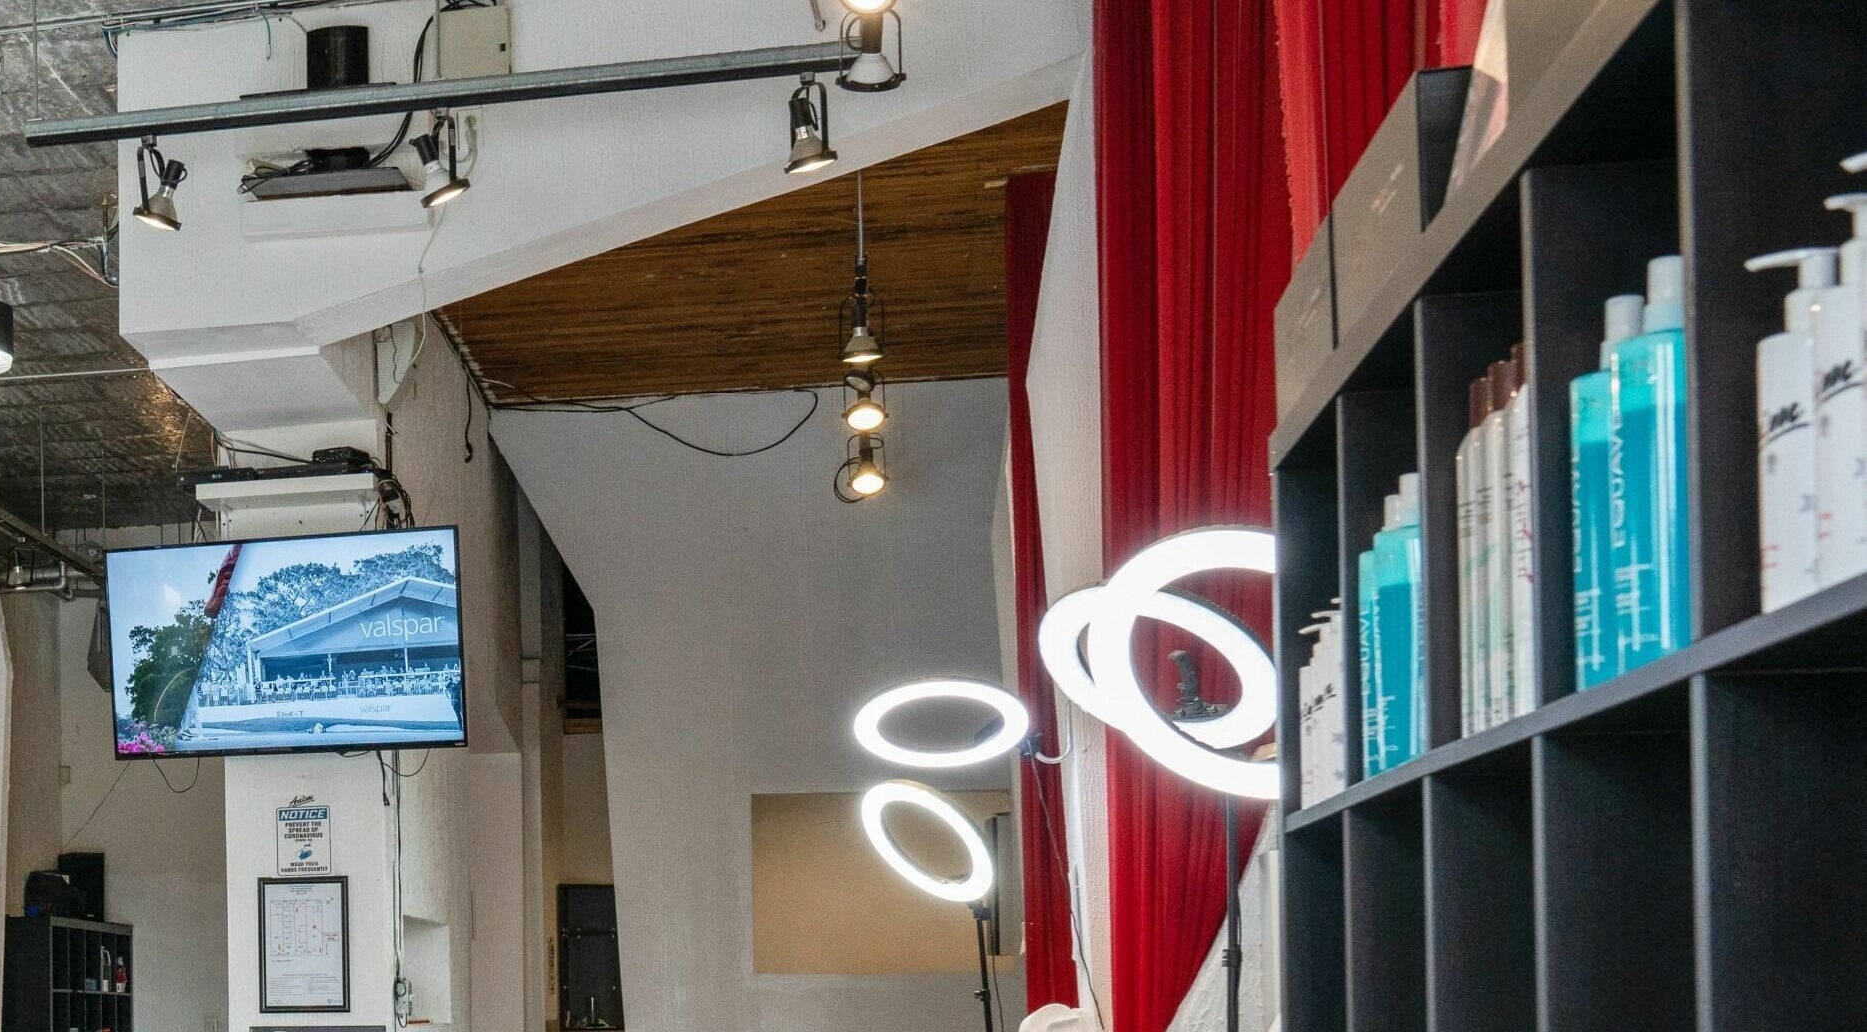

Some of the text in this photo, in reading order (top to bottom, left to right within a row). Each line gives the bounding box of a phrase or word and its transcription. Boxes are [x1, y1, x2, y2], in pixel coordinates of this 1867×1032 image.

[360, 613, 442, 641] valspar
[359, 703, 391, 715] valspar
[280, 809, 326, 820] NOTICE
